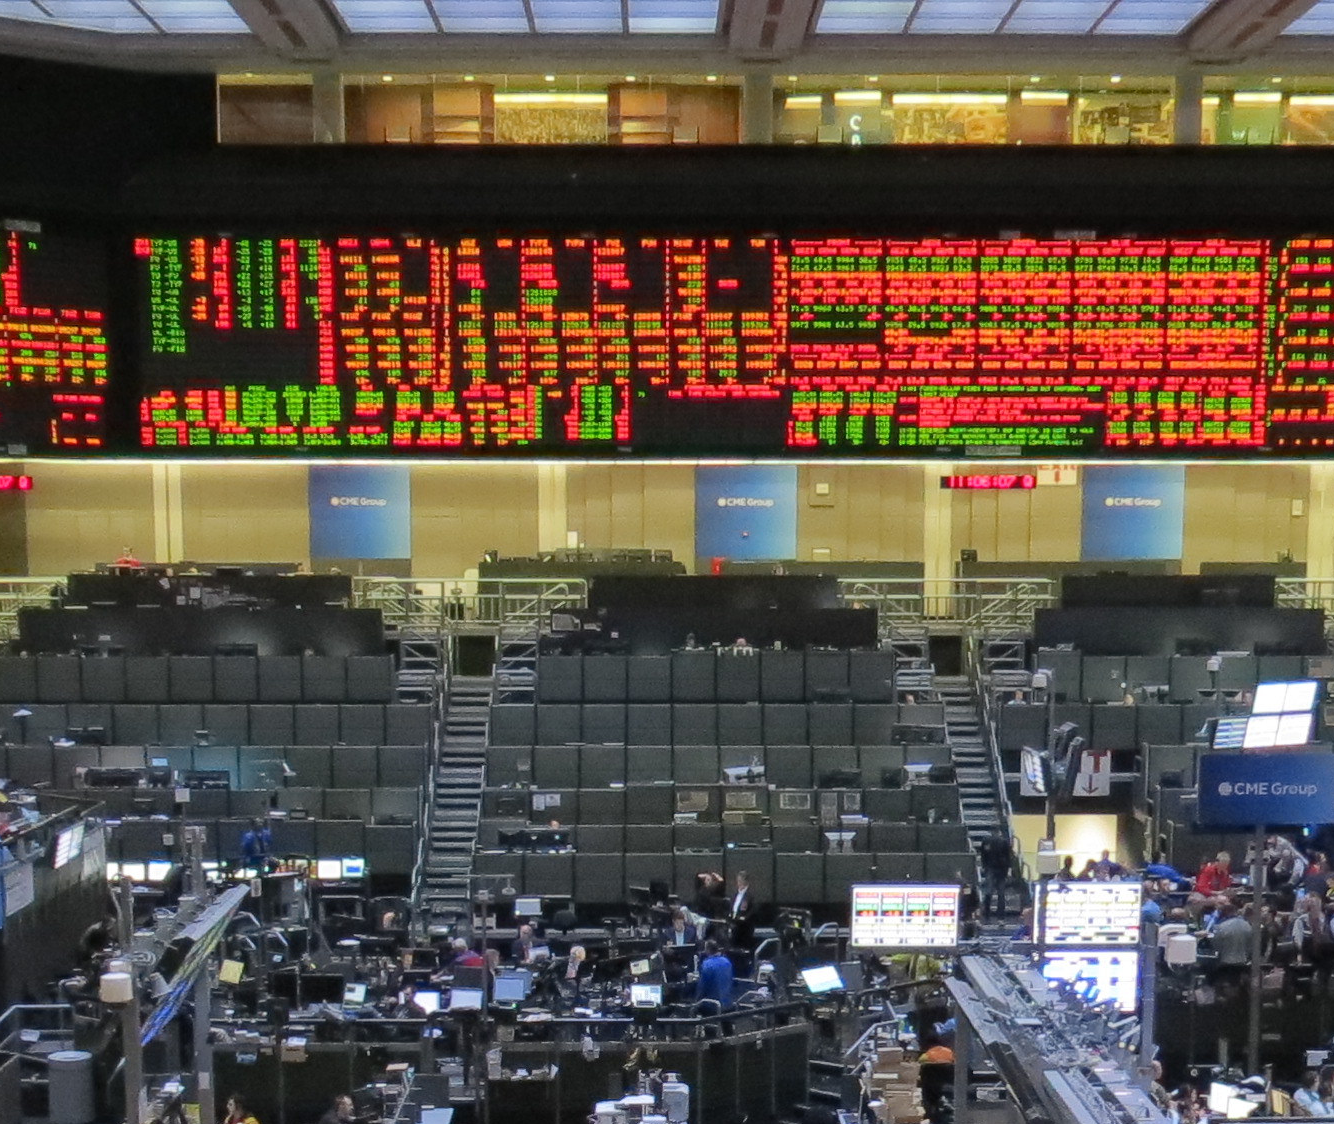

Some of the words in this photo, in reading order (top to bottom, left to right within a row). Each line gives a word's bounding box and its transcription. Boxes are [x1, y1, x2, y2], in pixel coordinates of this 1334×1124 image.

[949, 475, 1018, 487] 11:06:07
[339, 497, 360, 506] CME
[360, 497, 387, 506] Group
[727, 498, 746, 506] CME
[747, 498, 774, 507] Group
[1114, 497, 1133, 506] CME
[1134, 497, 1161, 508] Group
[1234, 783, 1269, 796] CME
[1271, 782, 1317, 797] Group
